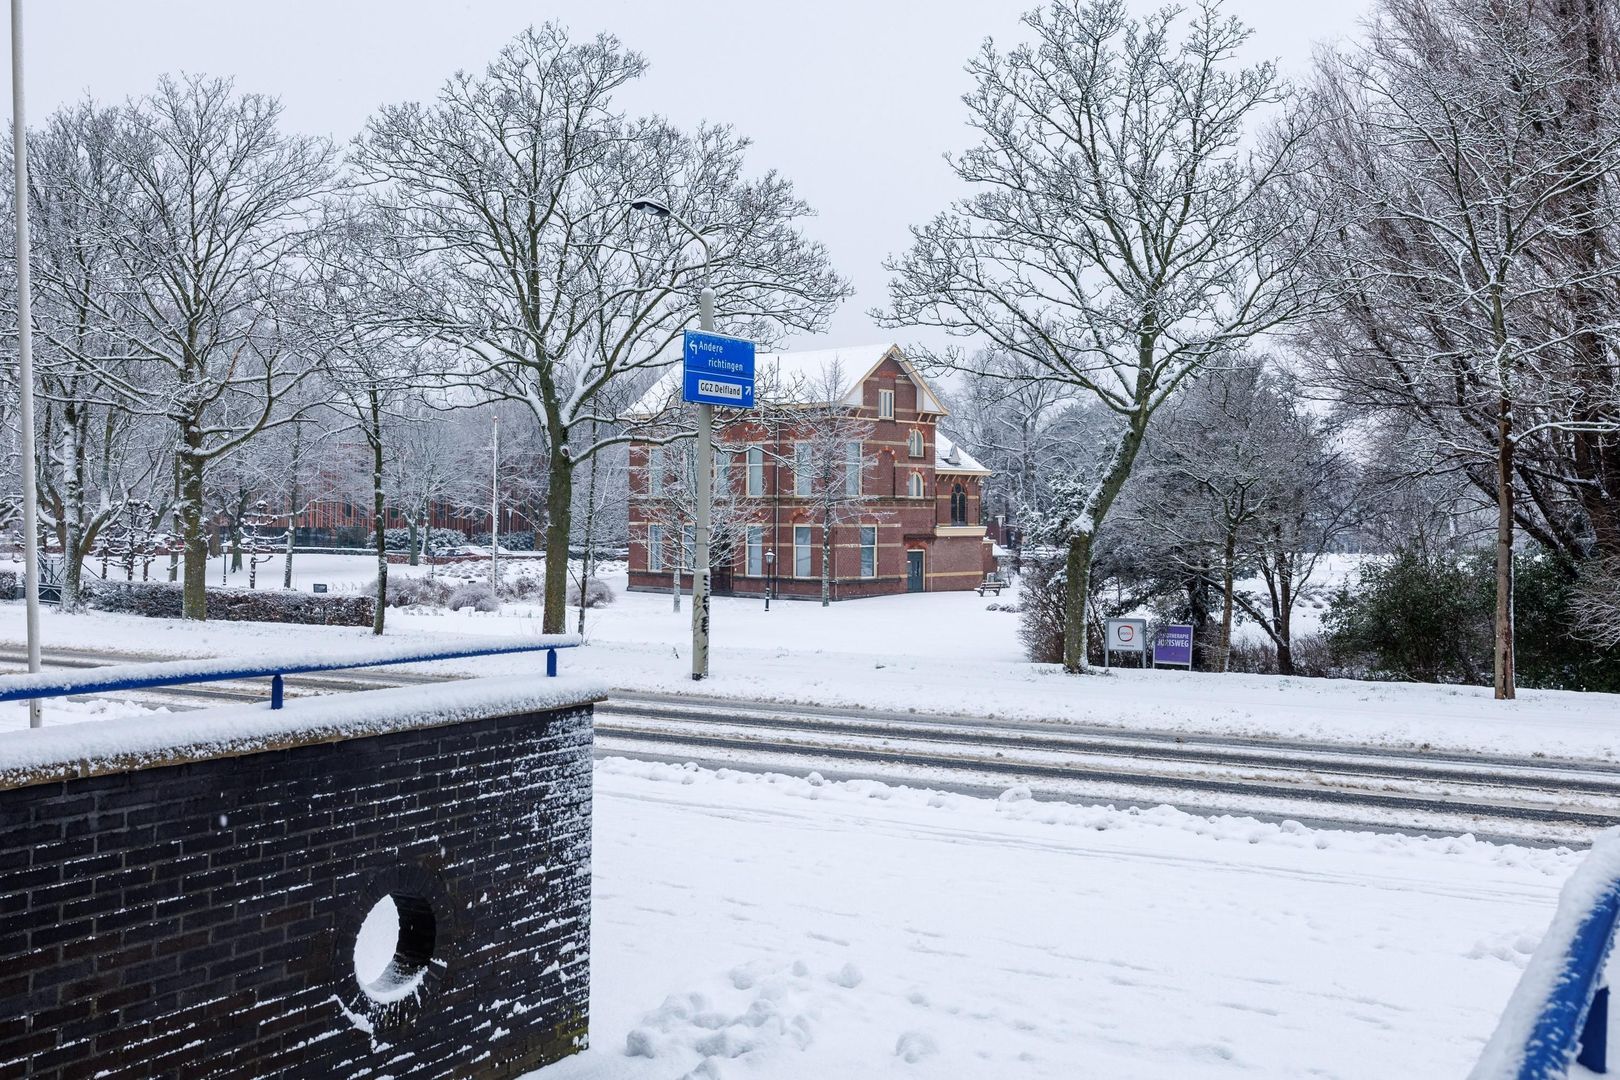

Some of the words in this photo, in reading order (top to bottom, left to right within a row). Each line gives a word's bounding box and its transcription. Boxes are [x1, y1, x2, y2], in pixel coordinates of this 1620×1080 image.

[699, 341, 723, 353] Andere
[709, 358, 743, 372] richtingen
[700, 382, 713, 393] GGZ
[715, 385, 740, 395] Delfland
